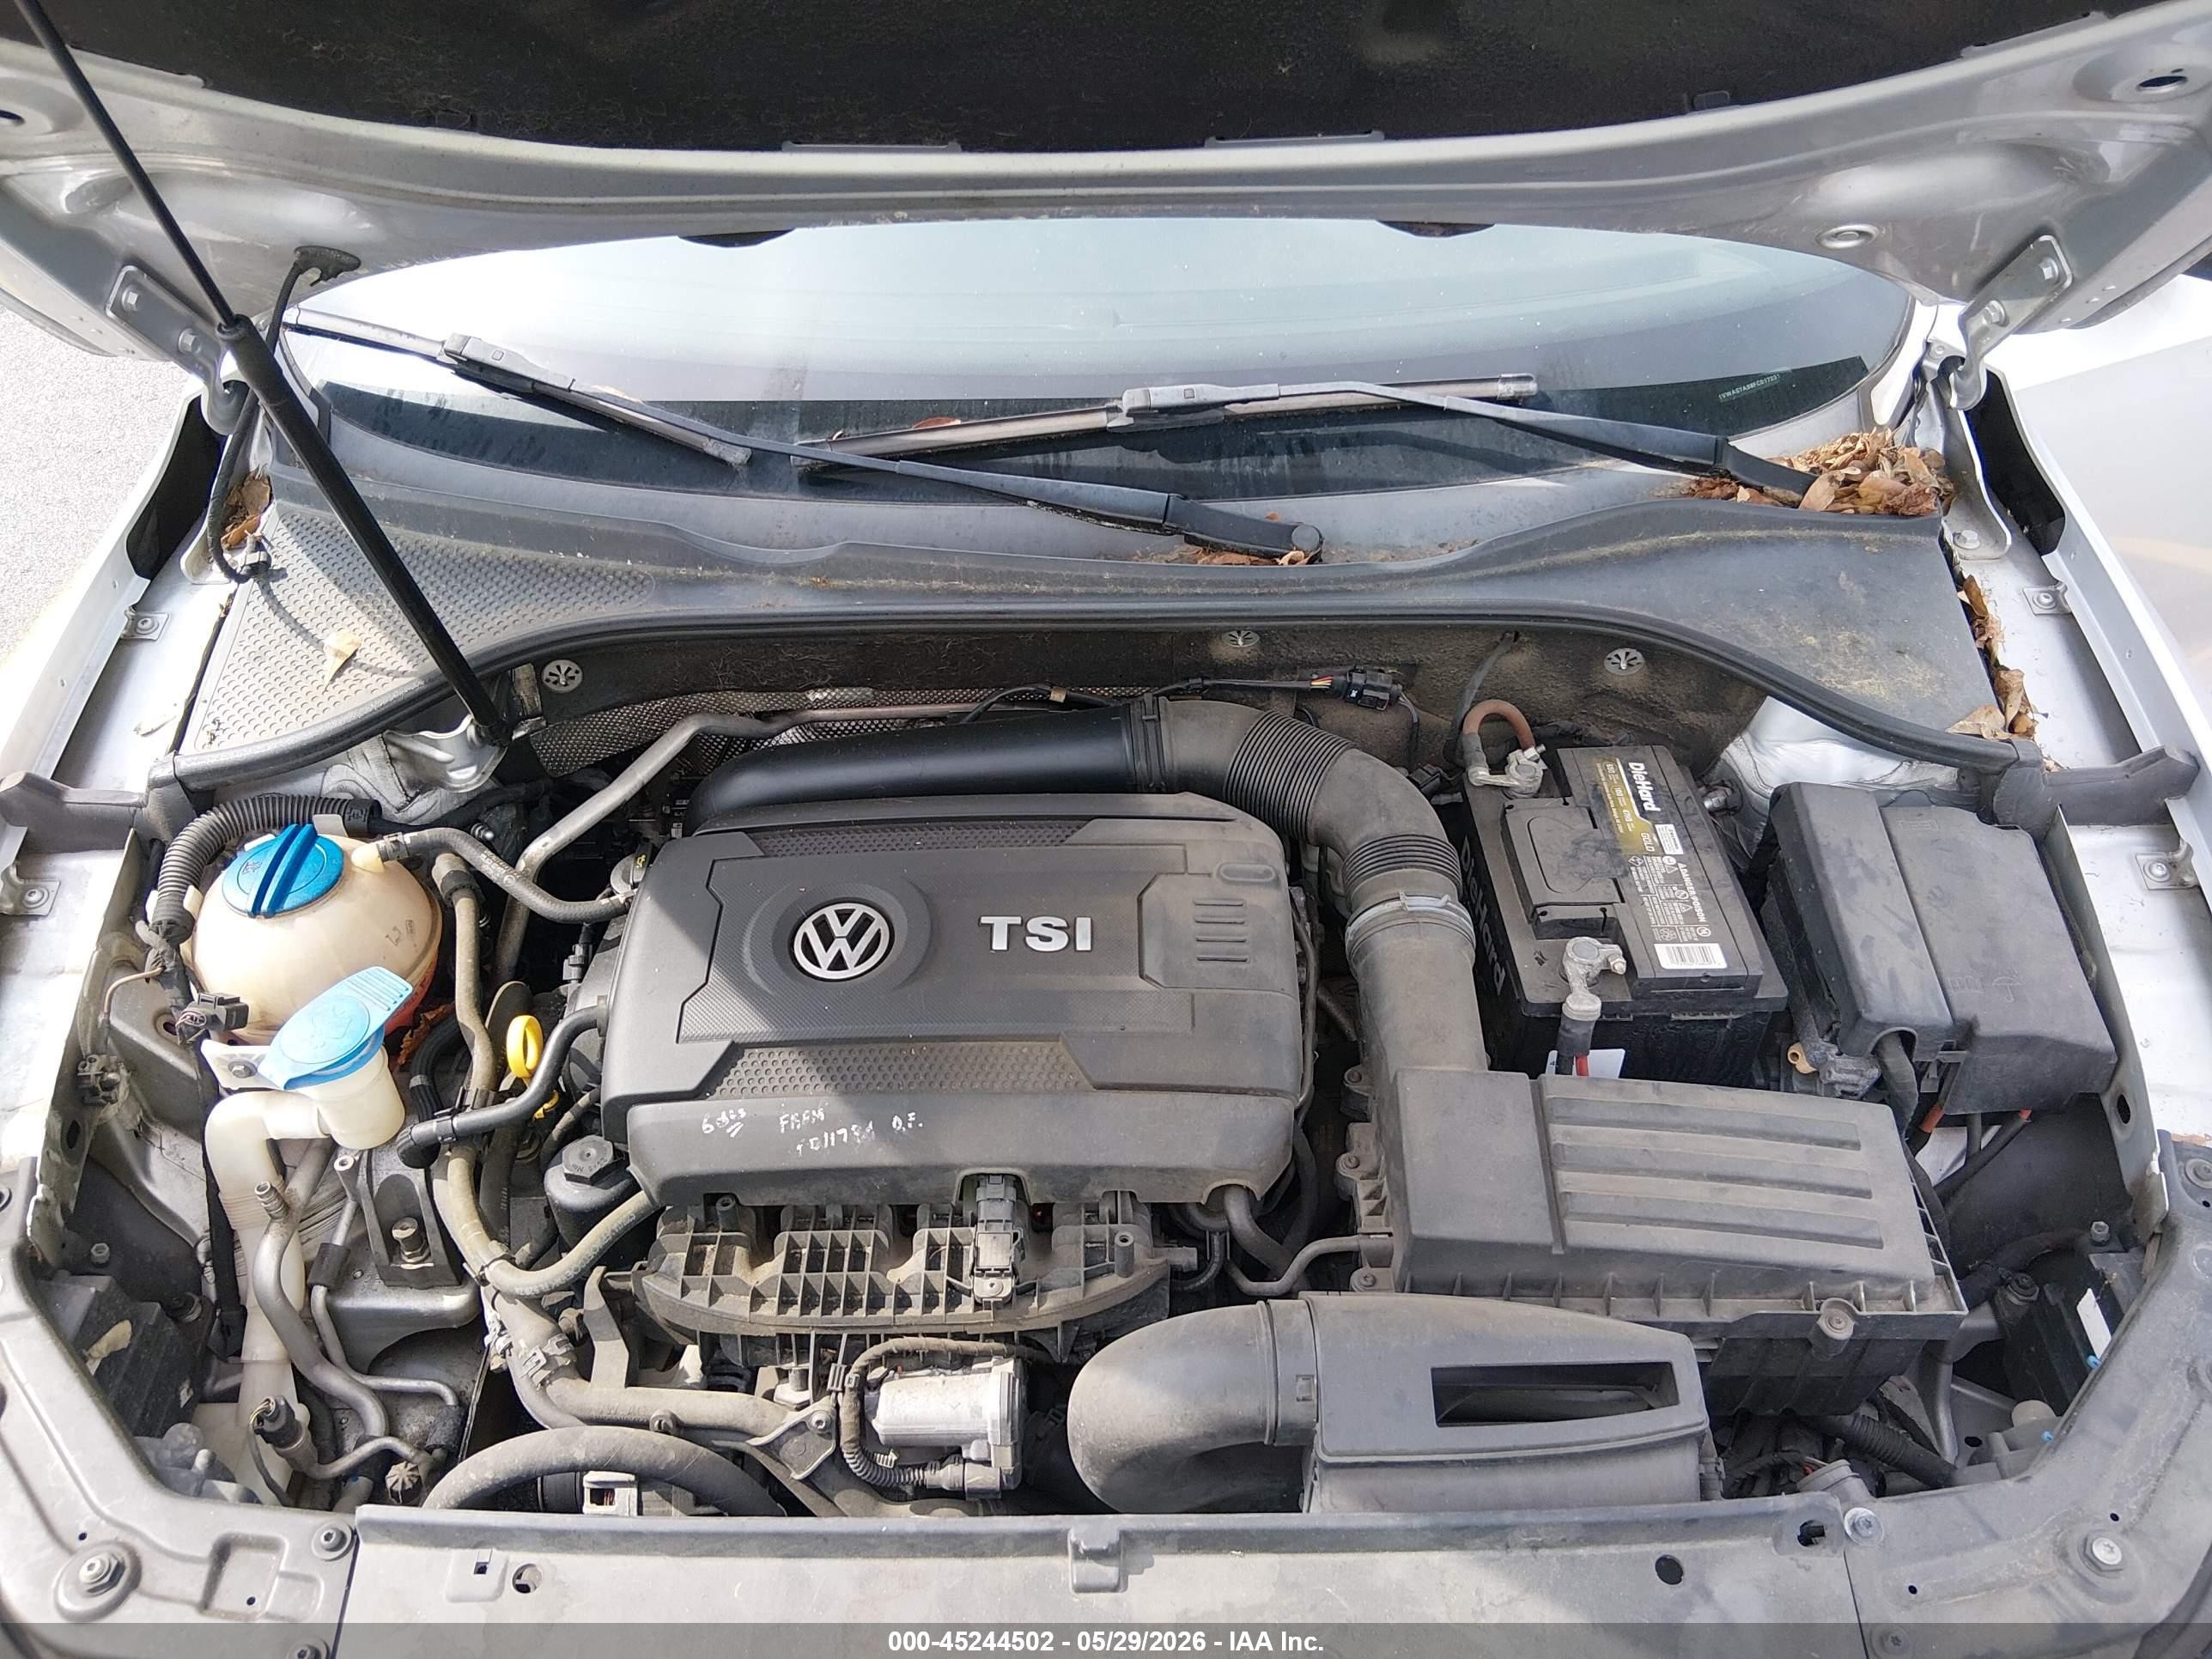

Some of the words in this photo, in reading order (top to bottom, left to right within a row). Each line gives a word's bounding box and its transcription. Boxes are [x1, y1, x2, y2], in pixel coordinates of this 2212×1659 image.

[1628, 762, 1662, 811] DieHard
[1641, 832, 1656, 852] GOLD
[980, 915, 1093, 952] TSI
[1462, 834, 1506, 996] DieHard
